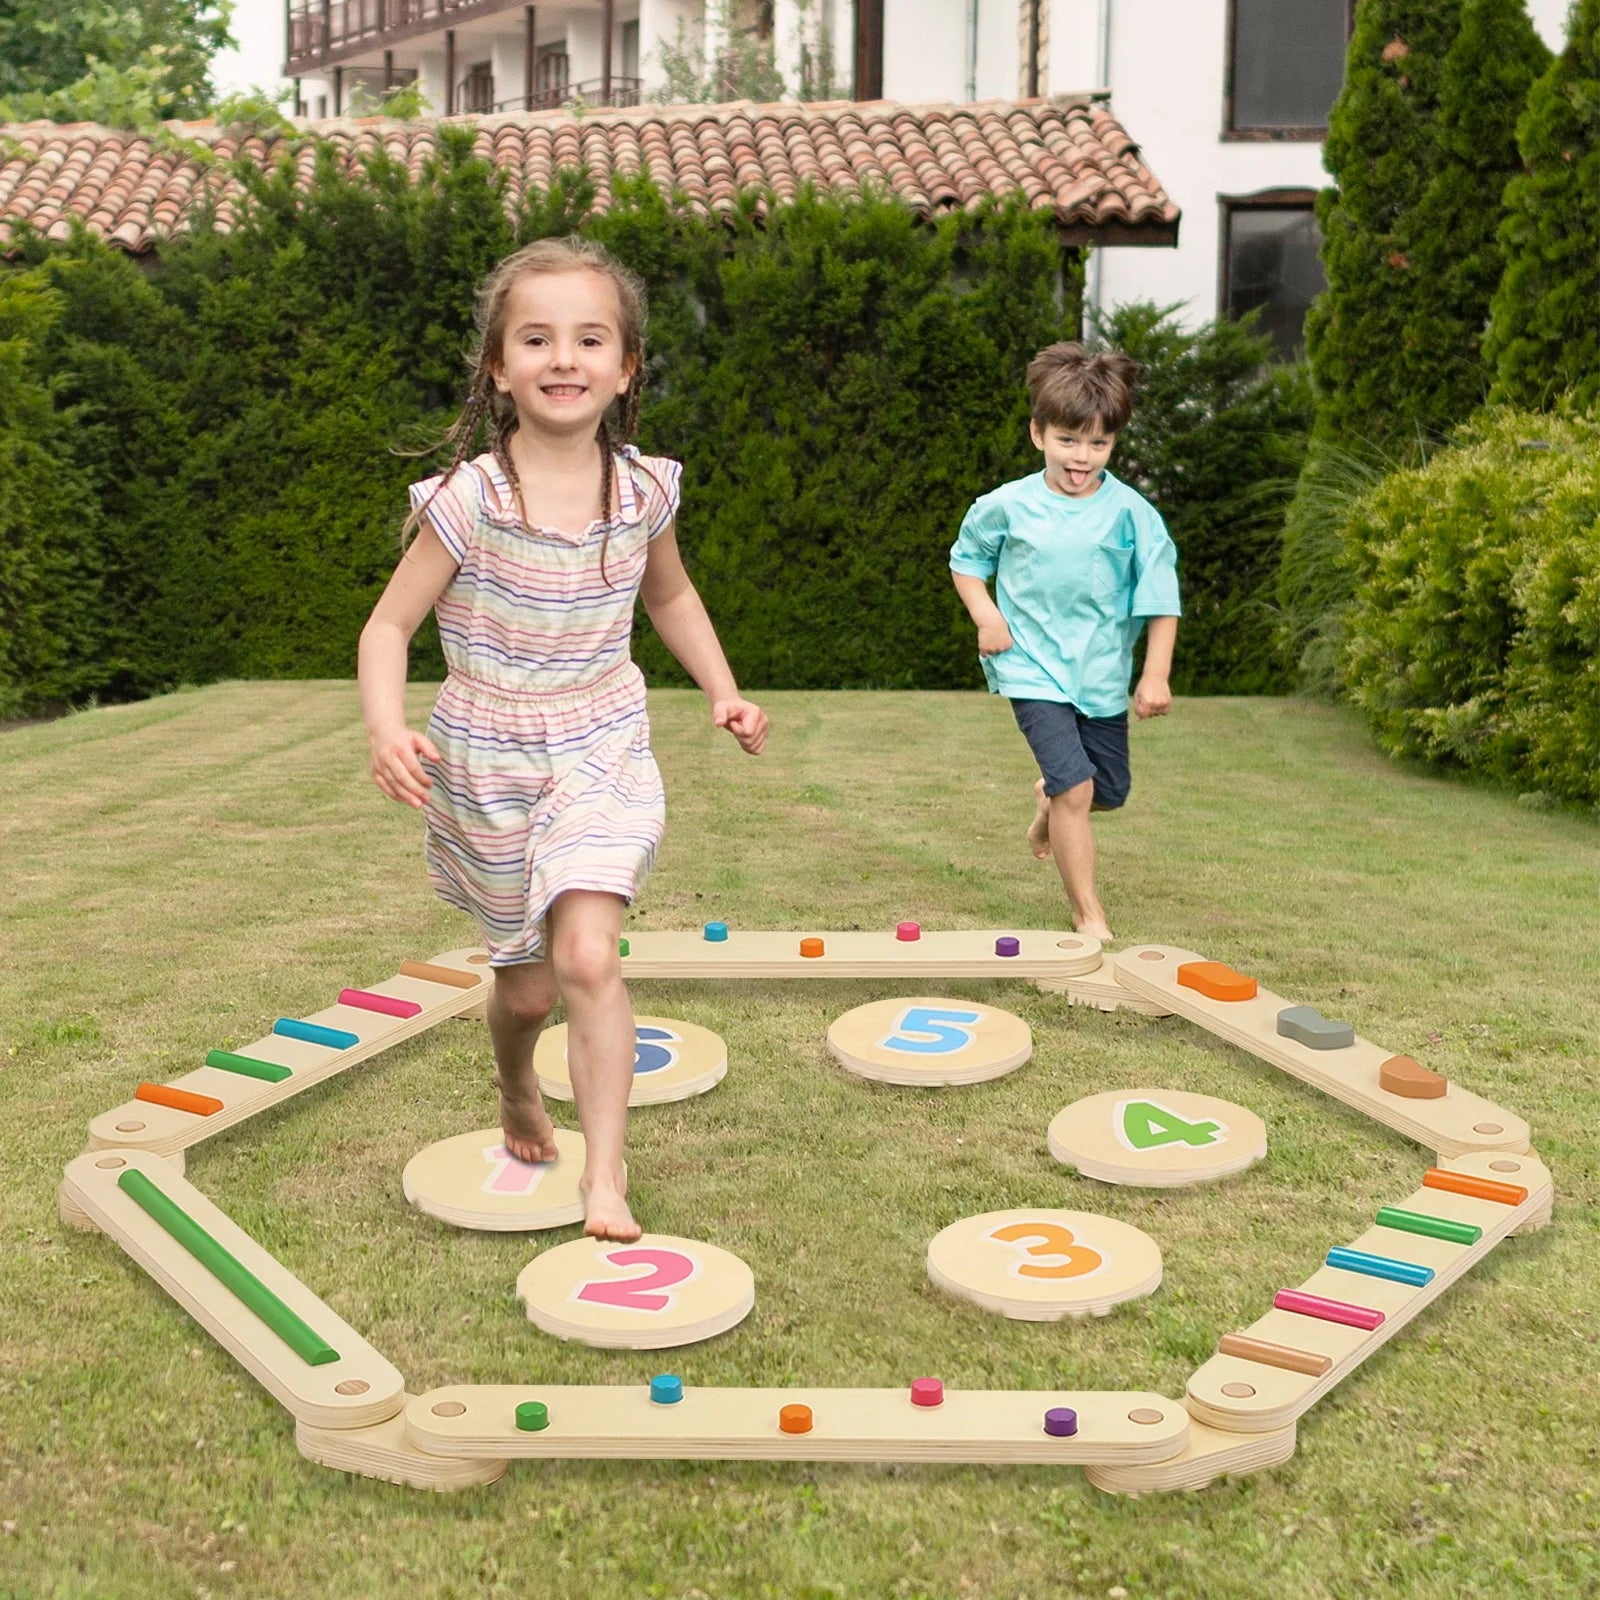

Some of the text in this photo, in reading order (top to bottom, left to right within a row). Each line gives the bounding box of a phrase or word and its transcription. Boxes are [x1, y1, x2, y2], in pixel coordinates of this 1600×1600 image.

[883, 1008, 979, 1054] 5
[1121, 1101, 1222, 1150] 4
[989, 1221, 1104, 1279] 3
[576, 1248, 694, 1312] 2
